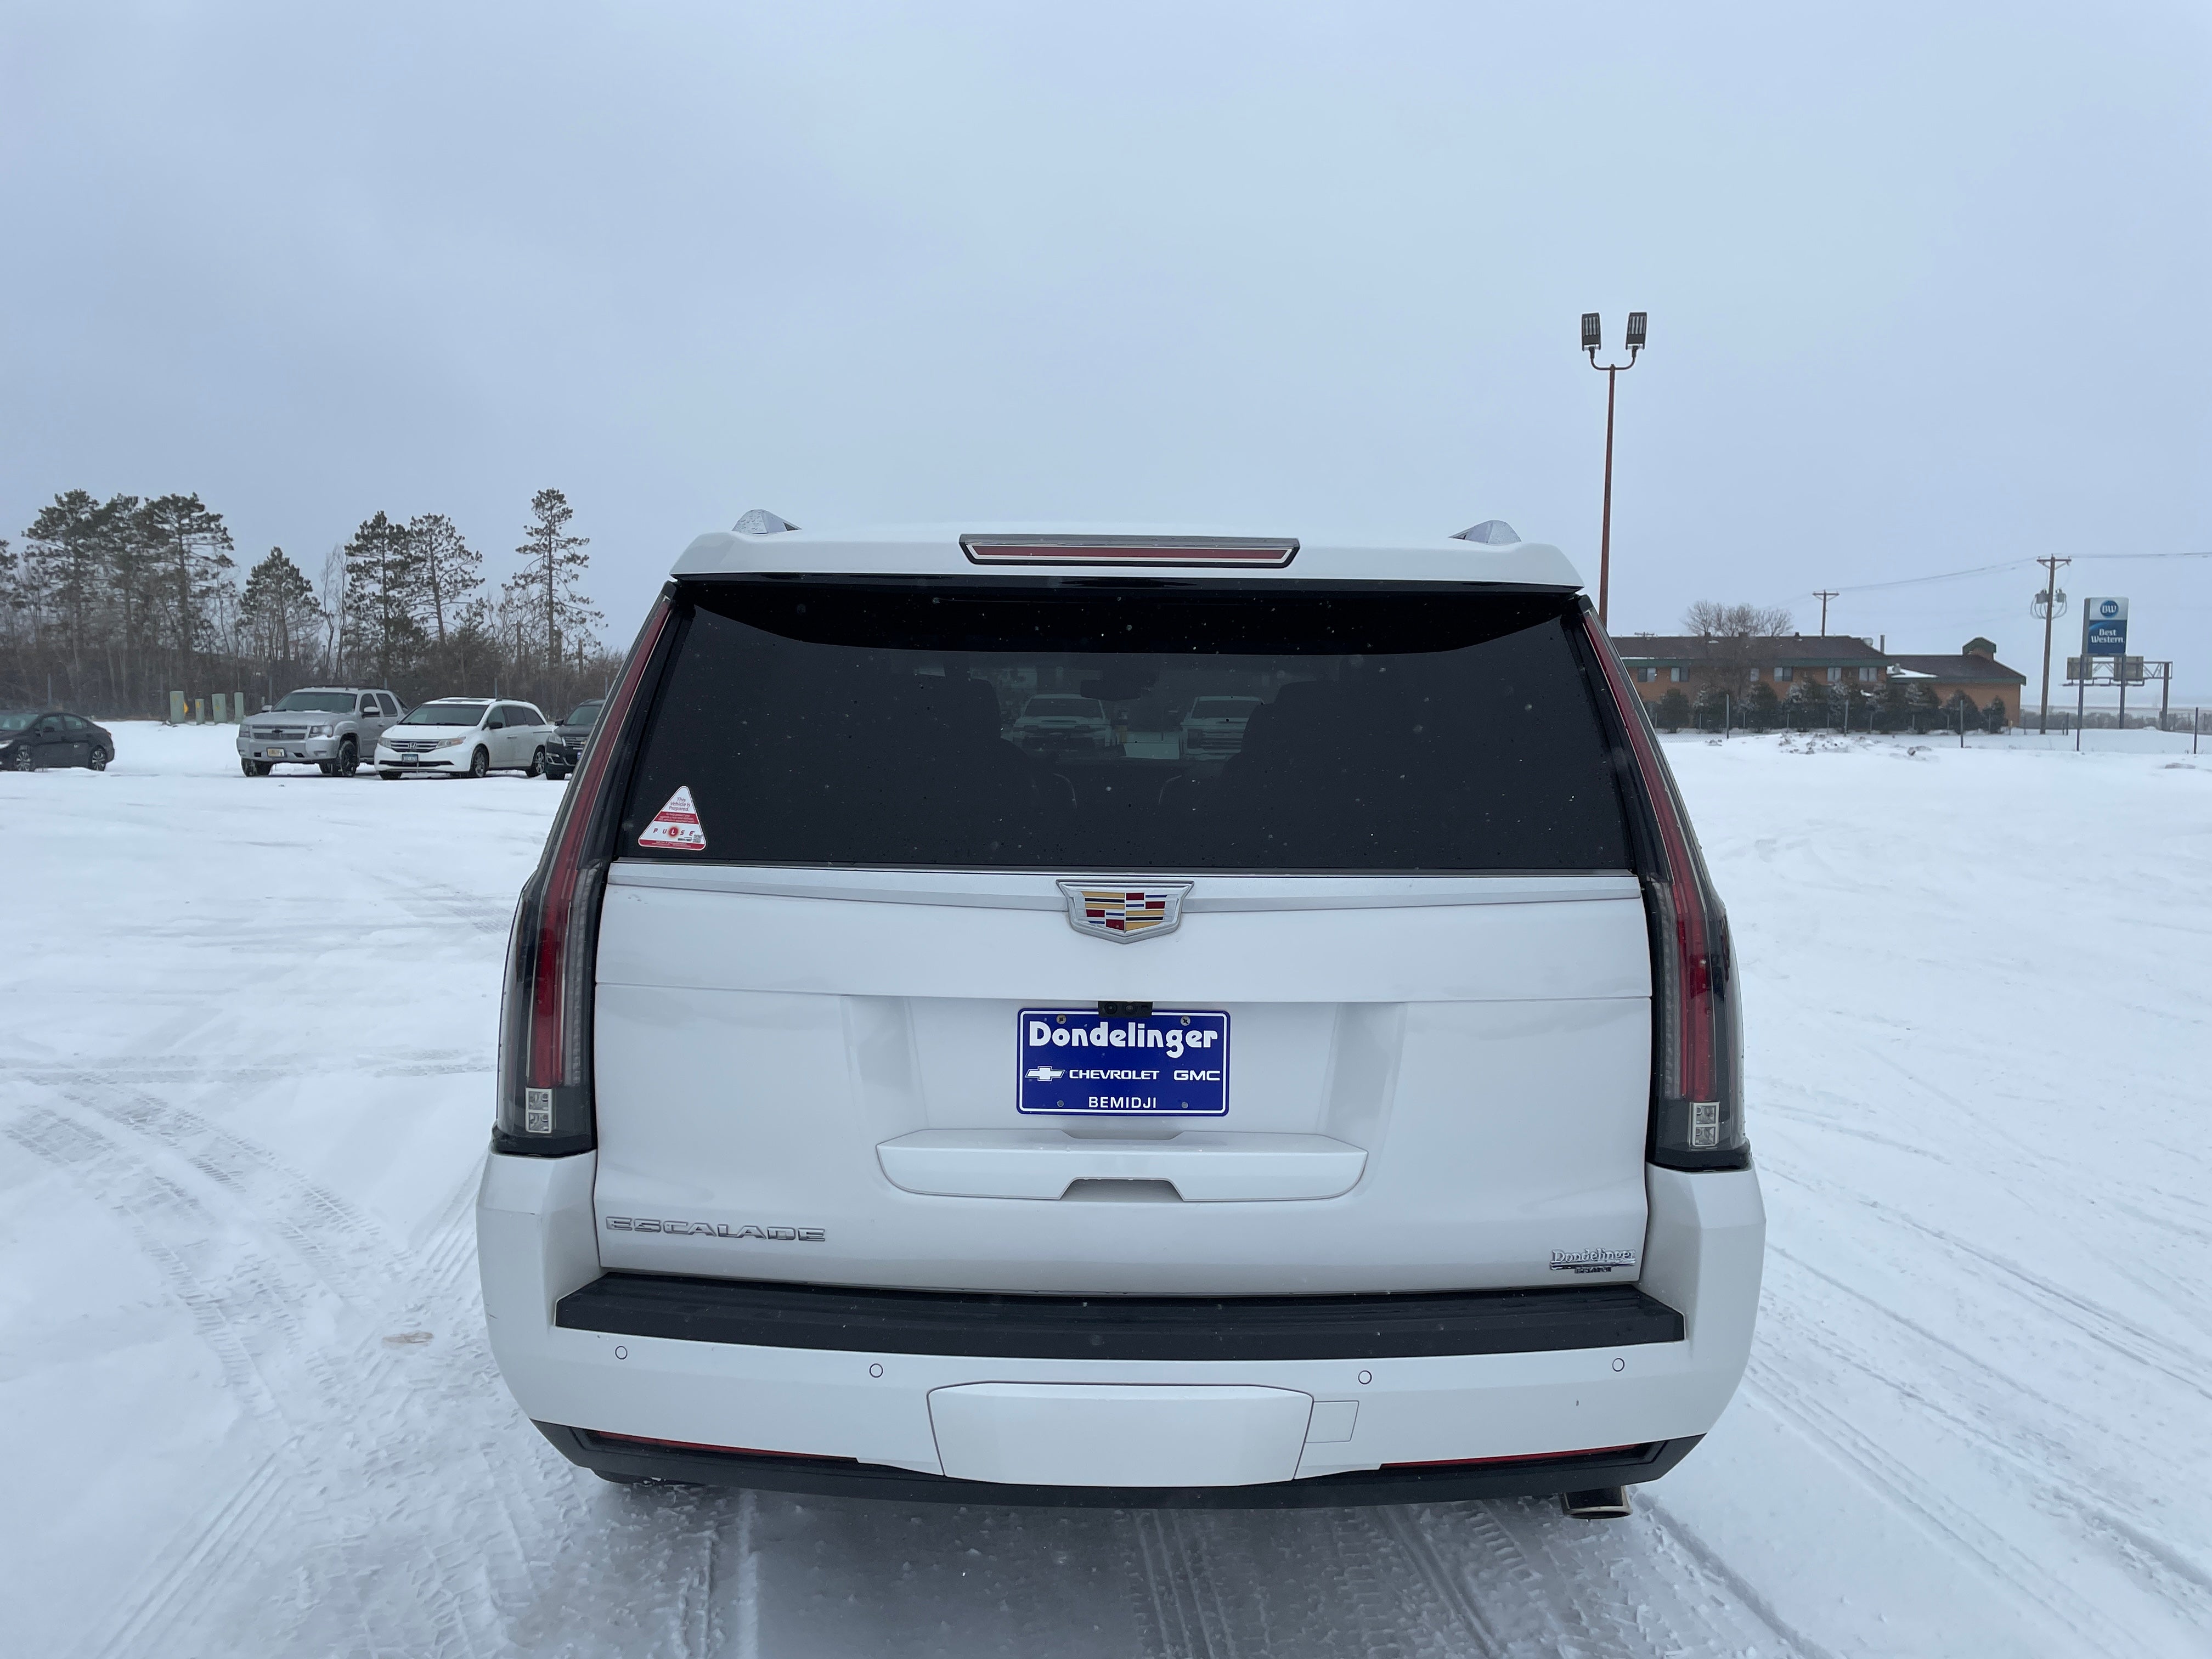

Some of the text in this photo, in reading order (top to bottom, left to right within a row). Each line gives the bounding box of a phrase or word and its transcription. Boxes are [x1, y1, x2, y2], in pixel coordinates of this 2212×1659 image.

[1029, 1021, 1218, 1059] Dondelinger
[1069, 1069, 1221, 1081] CHEVROLET GMC
[1088, 1096, 1156, 1109] BEMIDJI
[606, 1216, 826, 1242] ESCALADE
[1551, 1248, 1636, 1262] Dondelinger
